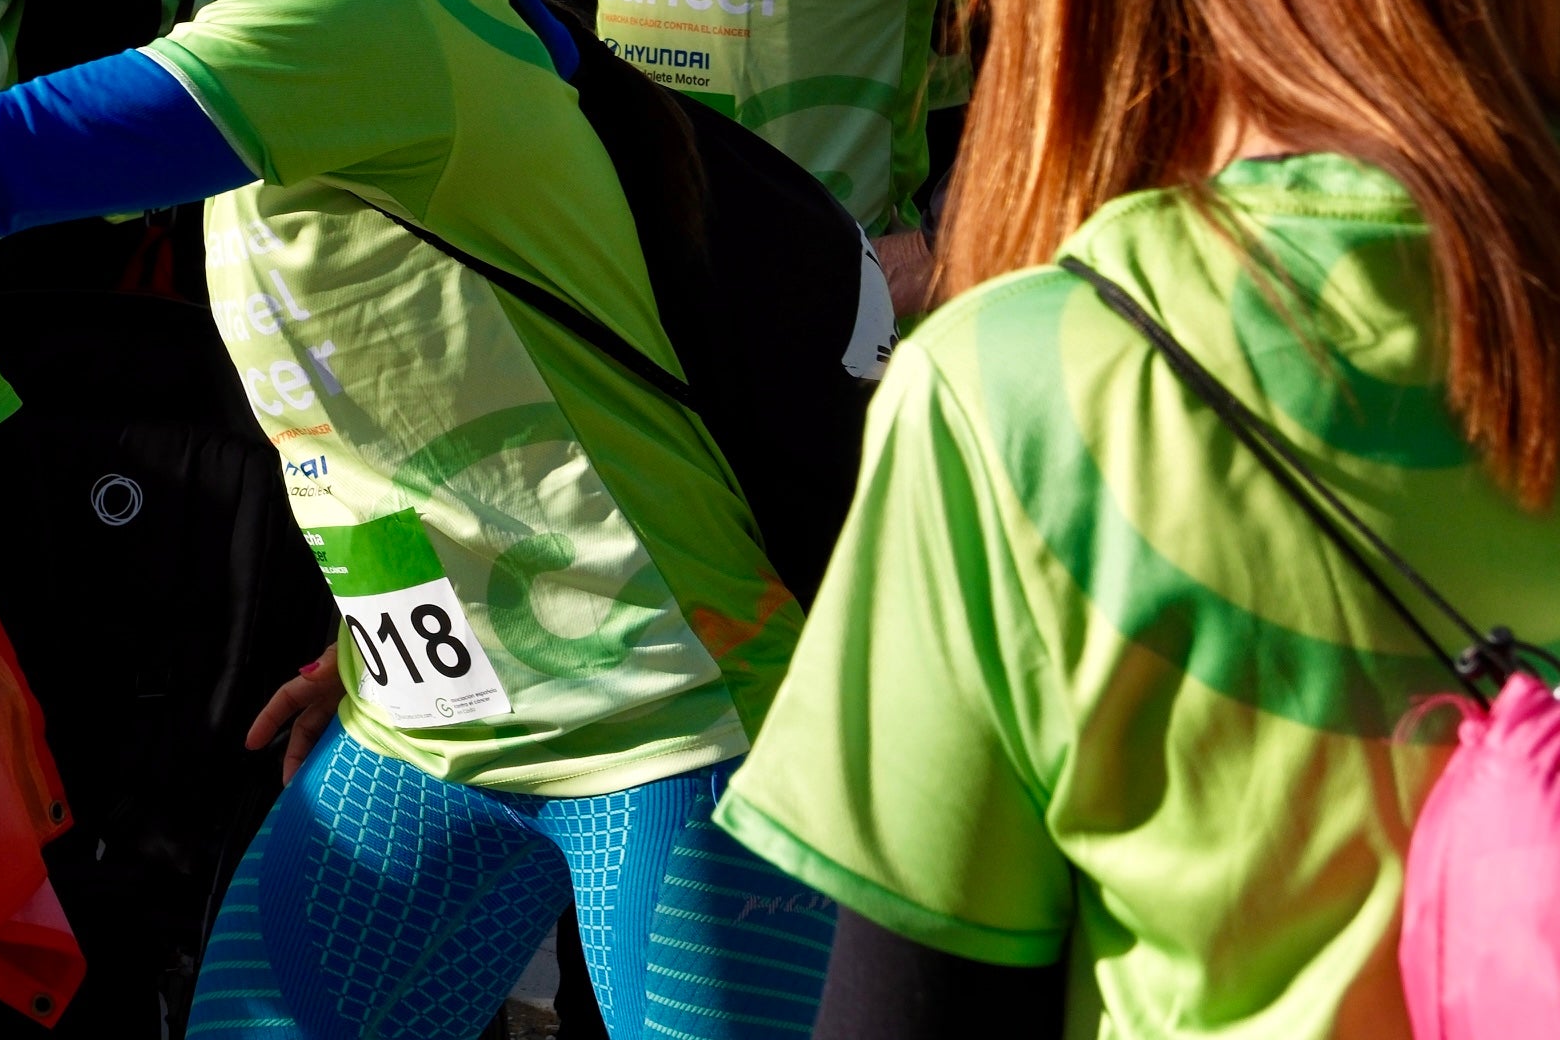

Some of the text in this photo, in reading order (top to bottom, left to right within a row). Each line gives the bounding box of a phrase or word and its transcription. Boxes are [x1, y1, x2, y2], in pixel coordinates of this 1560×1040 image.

[664, 21, 701, 33] CONTRA
[701, 24, 711, 34] EL
[713, 25, 751, 38] CÁNCER
[624, 44, 710, 70] HYUNDAI
[675, 73, 710, 87] Motor
[246, 269, 311, 335] el
